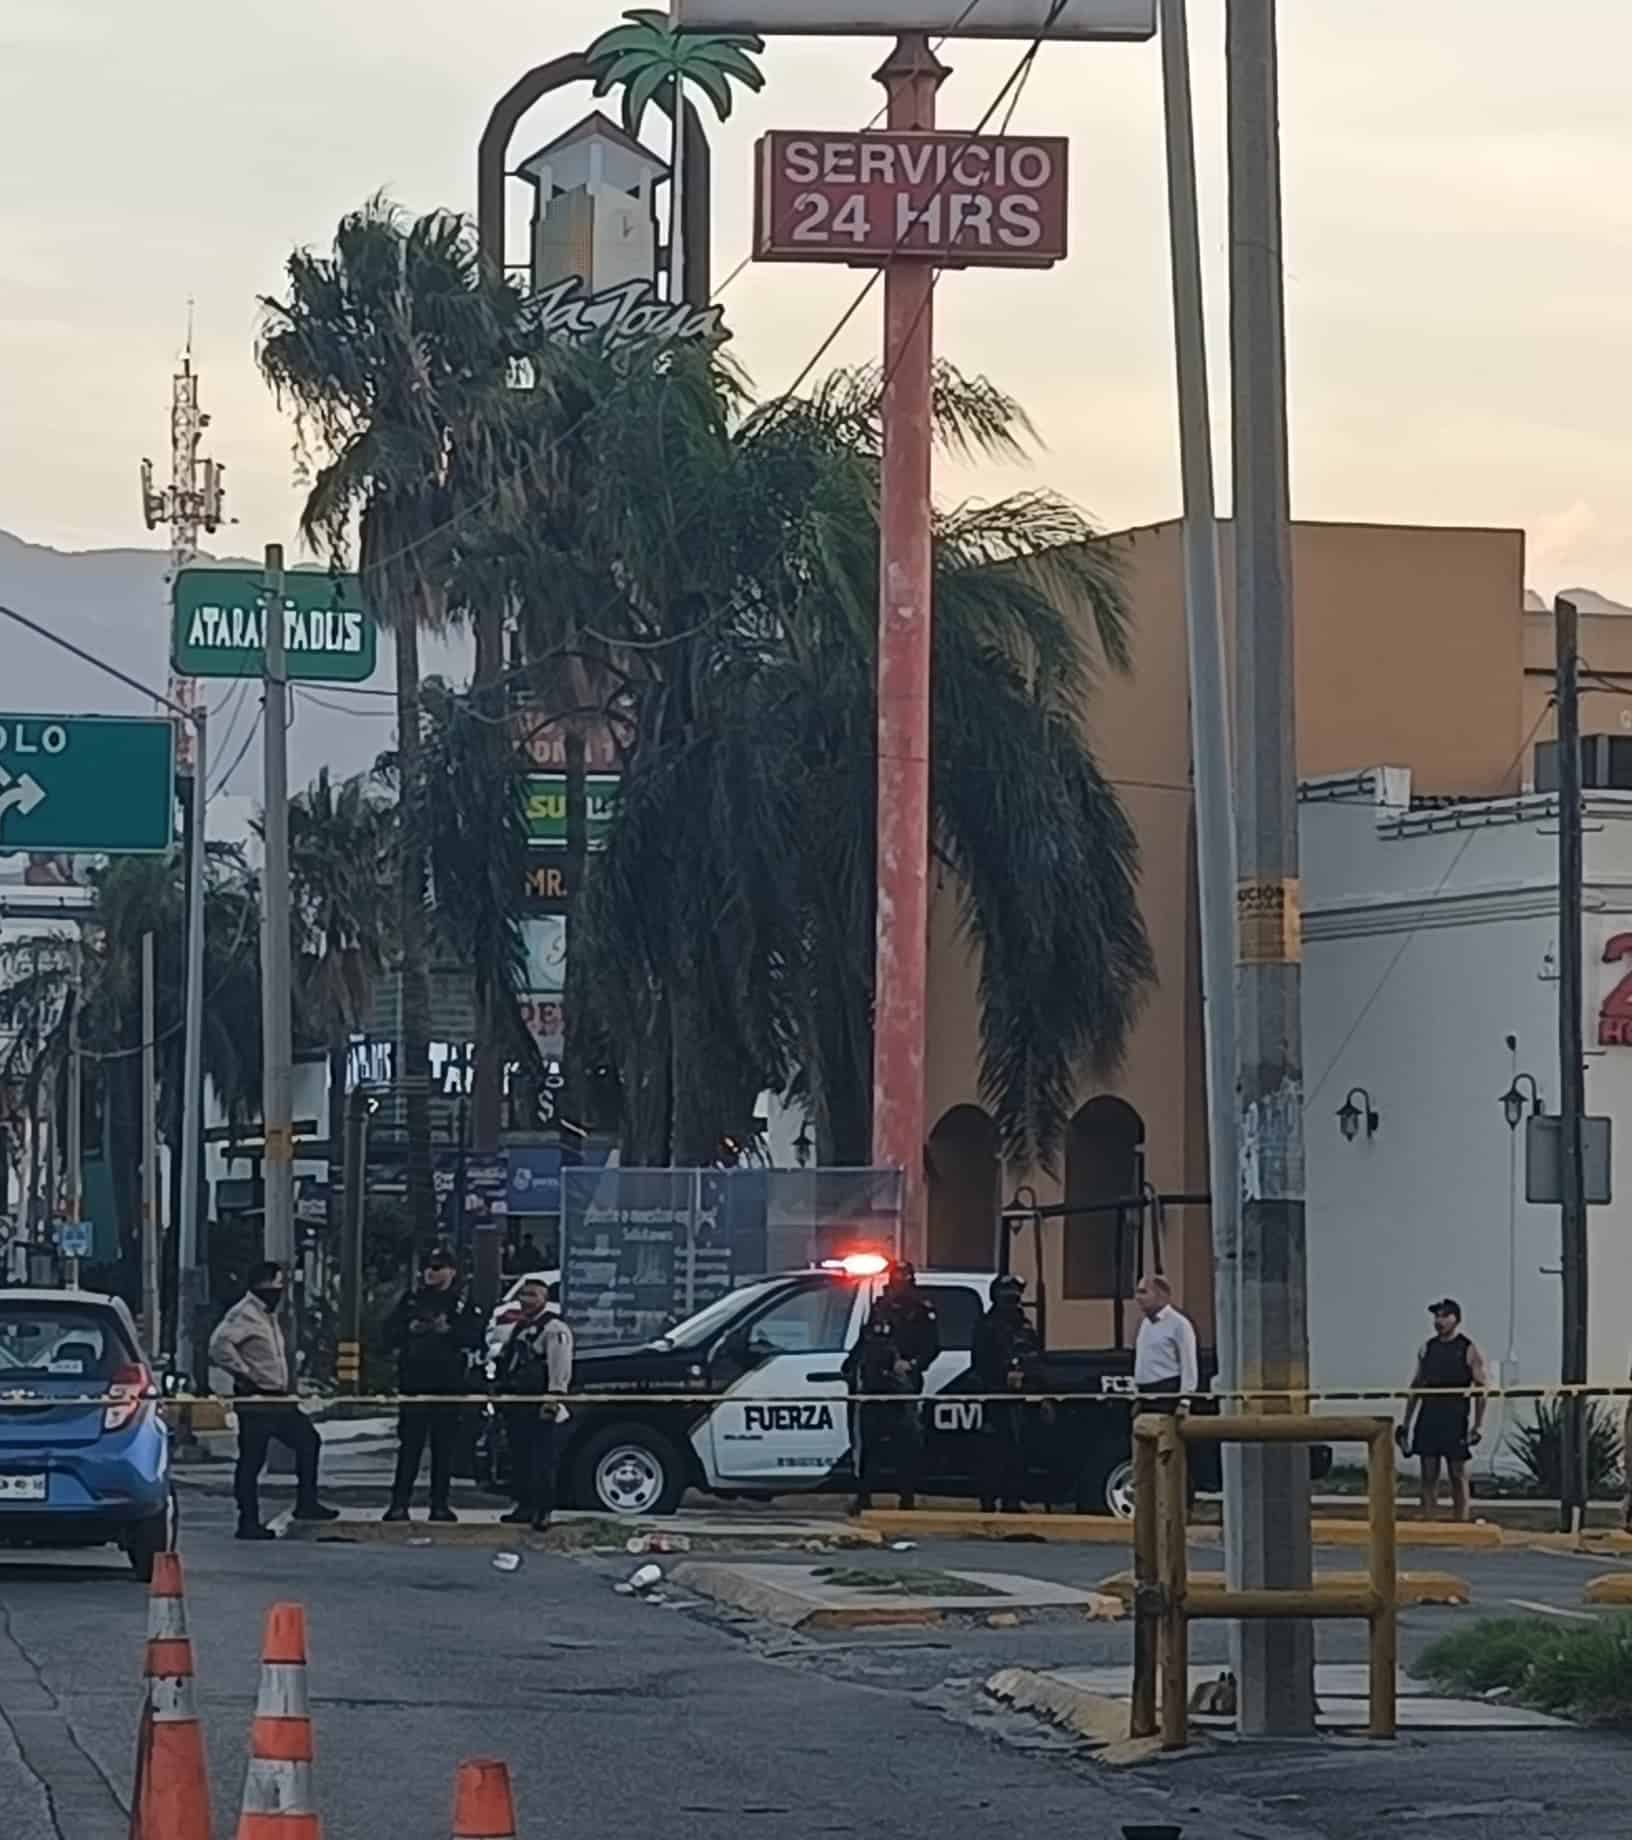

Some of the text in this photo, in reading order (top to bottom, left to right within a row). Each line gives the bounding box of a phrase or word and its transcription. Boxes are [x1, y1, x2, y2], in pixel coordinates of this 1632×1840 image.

[783, 141, 1053, 189] SERVICIO
[792, 192, 1042, 248] 24 HRS
[743, 1405, 834, 1431] FUERZA
